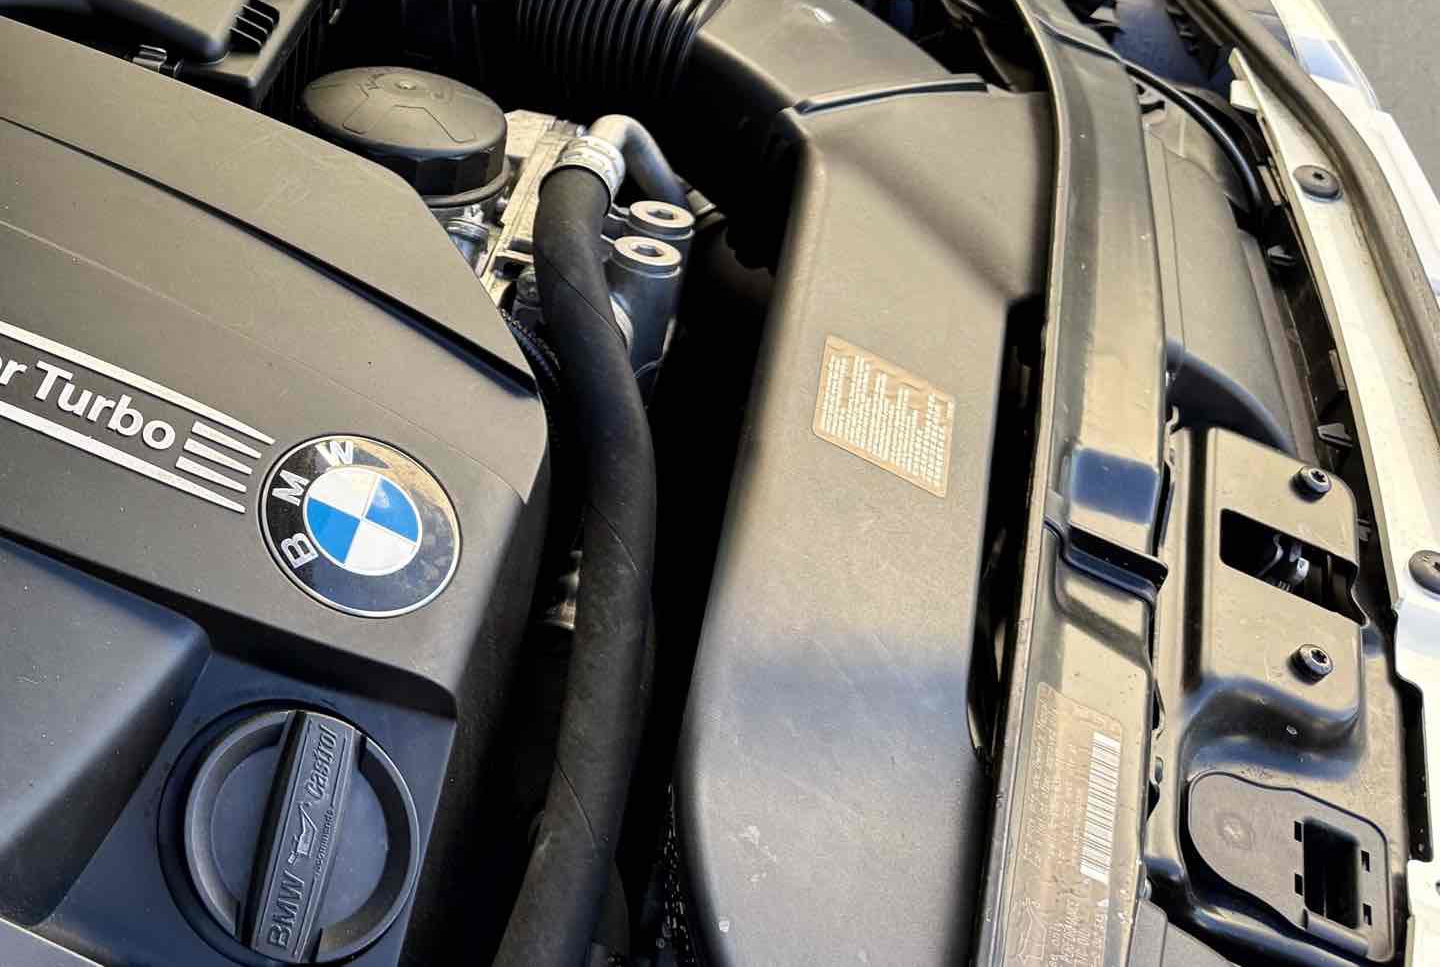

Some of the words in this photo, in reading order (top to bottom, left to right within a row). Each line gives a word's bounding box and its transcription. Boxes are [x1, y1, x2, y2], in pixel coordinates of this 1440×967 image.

[34, 360, 176, 450] Turbo
[271, 440, 354, 569] BMW
[267, 869, 305, 948] BMW
[306, 723, 338, 800] Castrol
